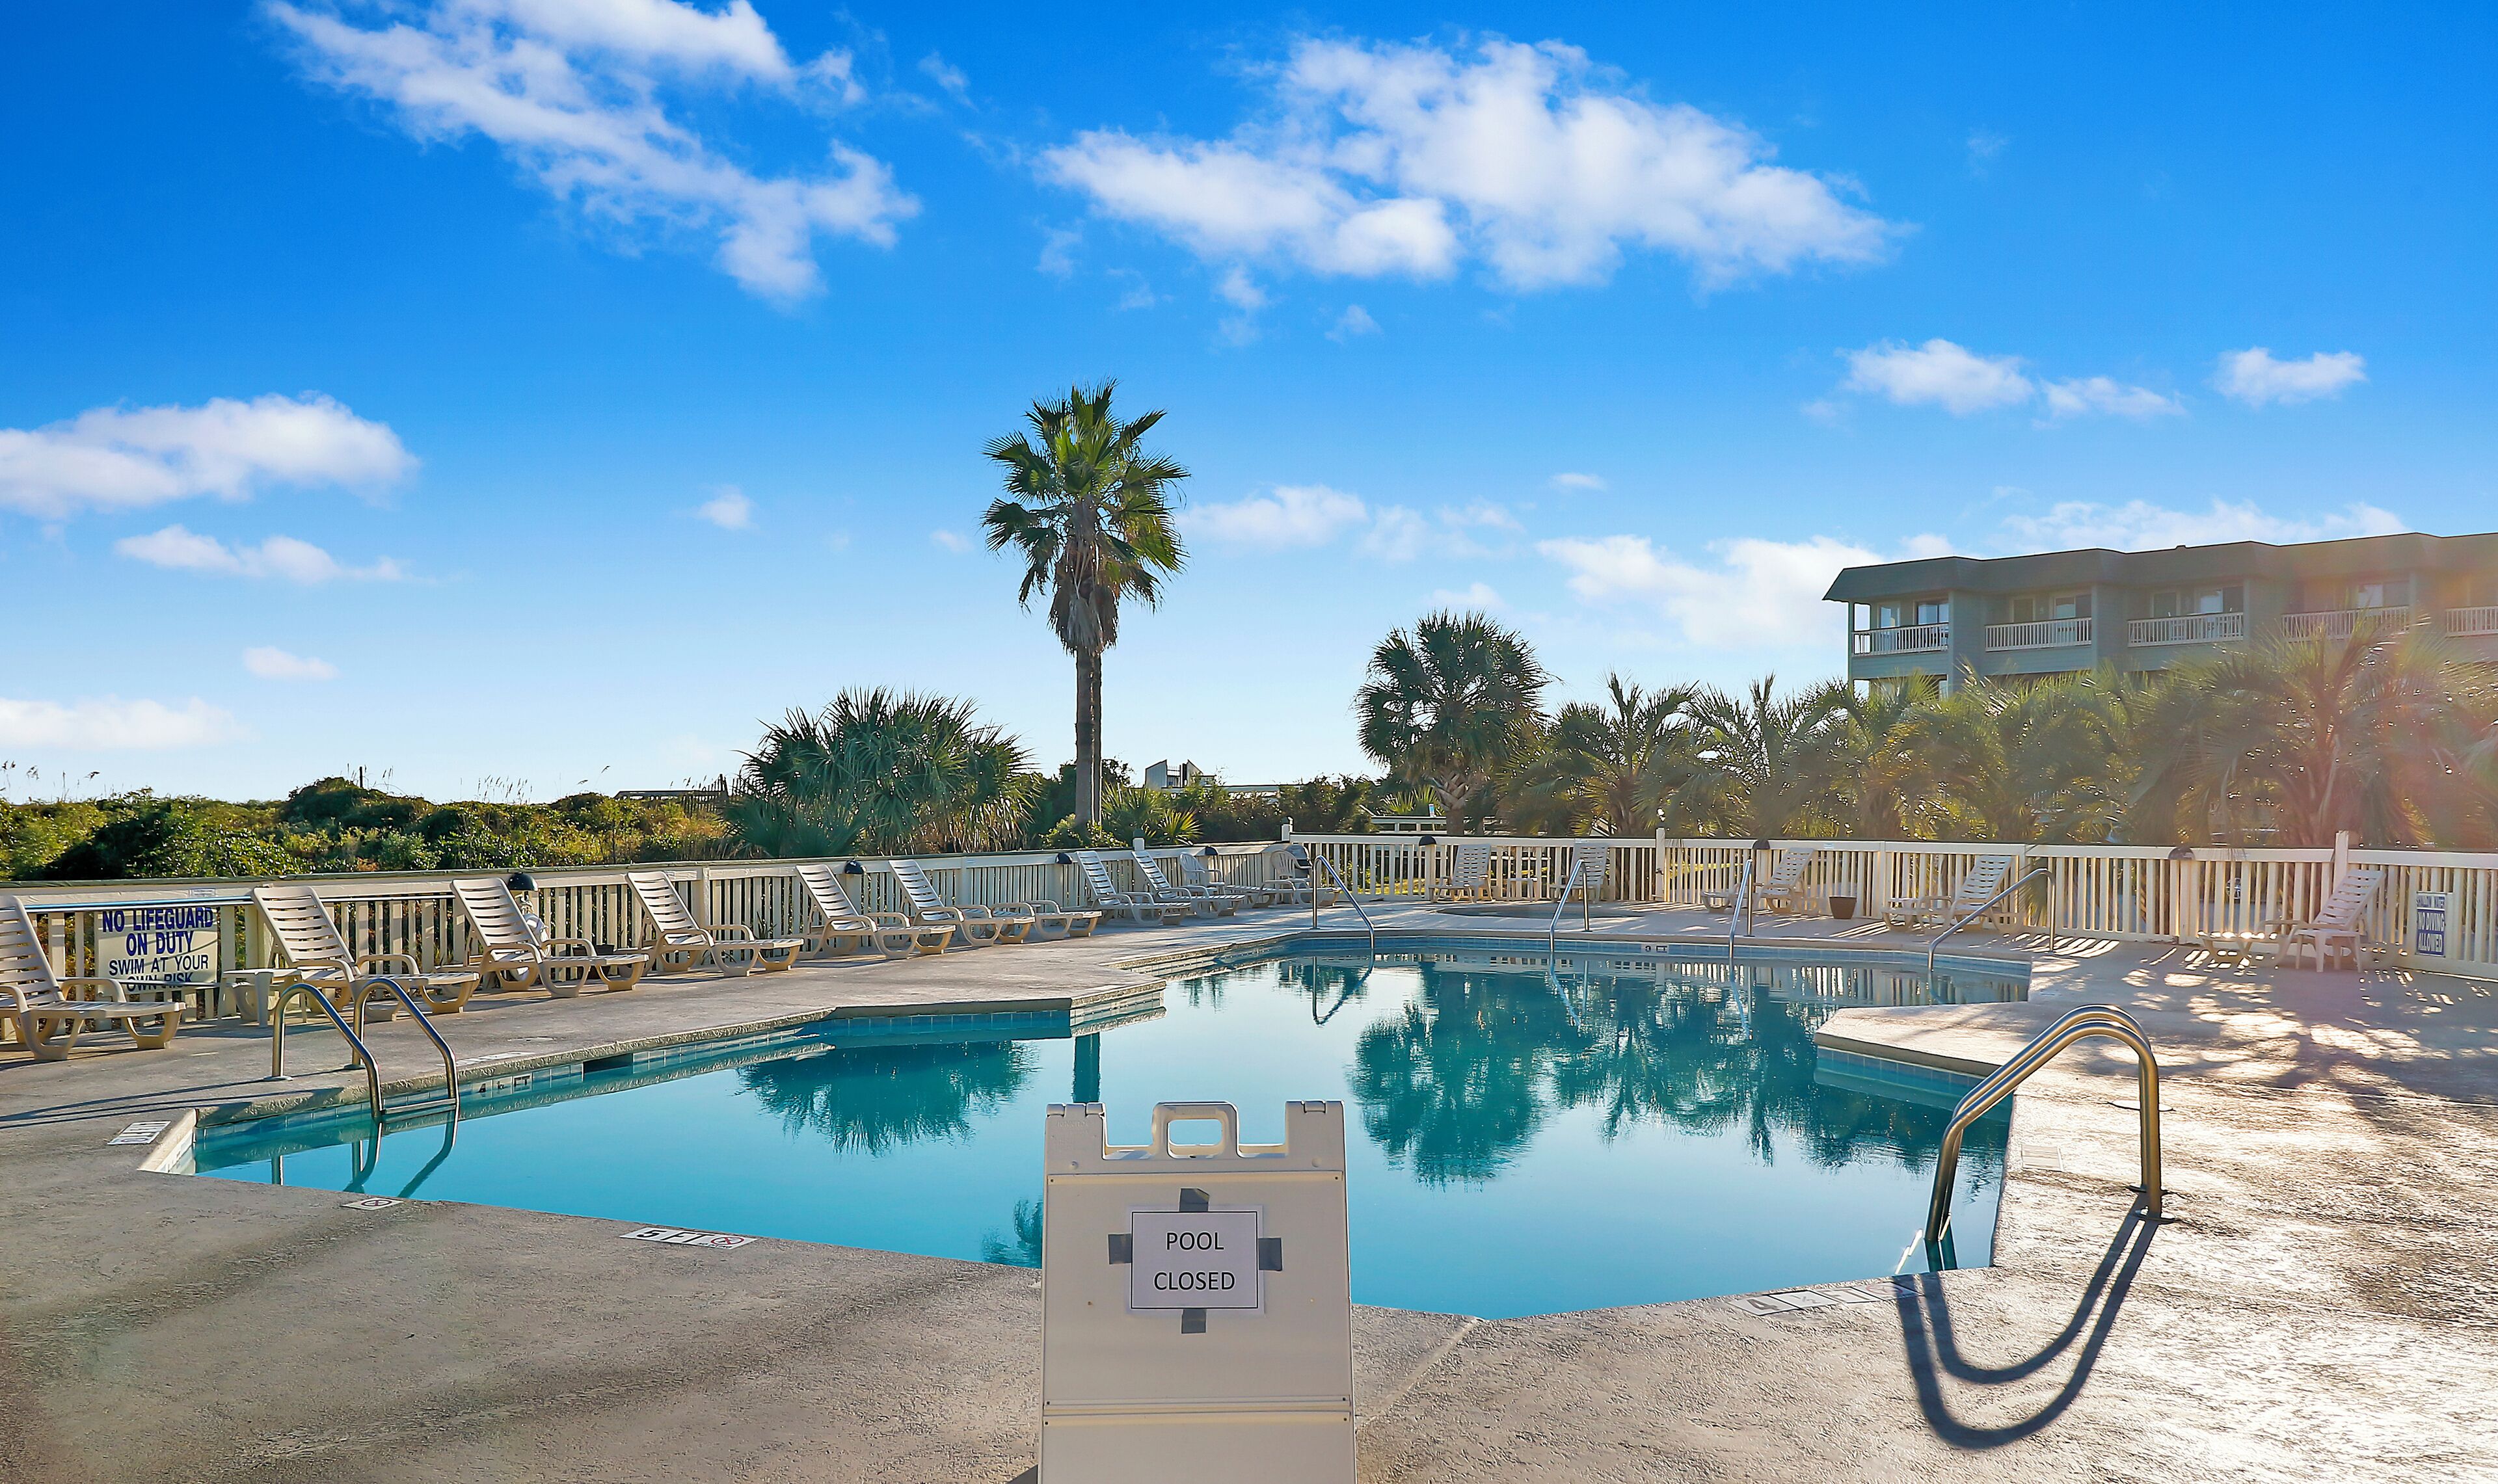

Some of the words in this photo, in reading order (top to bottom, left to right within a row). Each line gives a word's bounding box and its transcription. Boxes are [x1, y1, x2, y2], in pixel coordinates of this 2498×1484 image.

[103, 910, 125, 933] NO
[133, 907, 213, 931] LIFEGUARD
[2426, 912, 2445, 932] DIVING
[126, 933, 148, 957] ON
[156, 931, 194, 955] DUTY
[2418, 933, 2443, 953] ALLOWED
[109, 958, 144, 976] SWIM
[151, 957, 168, 973] AT
[174, 954, 209, 972] YOUR
[636, 1229, 667, 1238] 5
[660, 1232, 716, 1243] FT
[1166, 1231, 1225, 1251] POOL
[1153, 1271, 1235, 1291] CLOSED
[1747, 1299, 1780, 1311] 4
